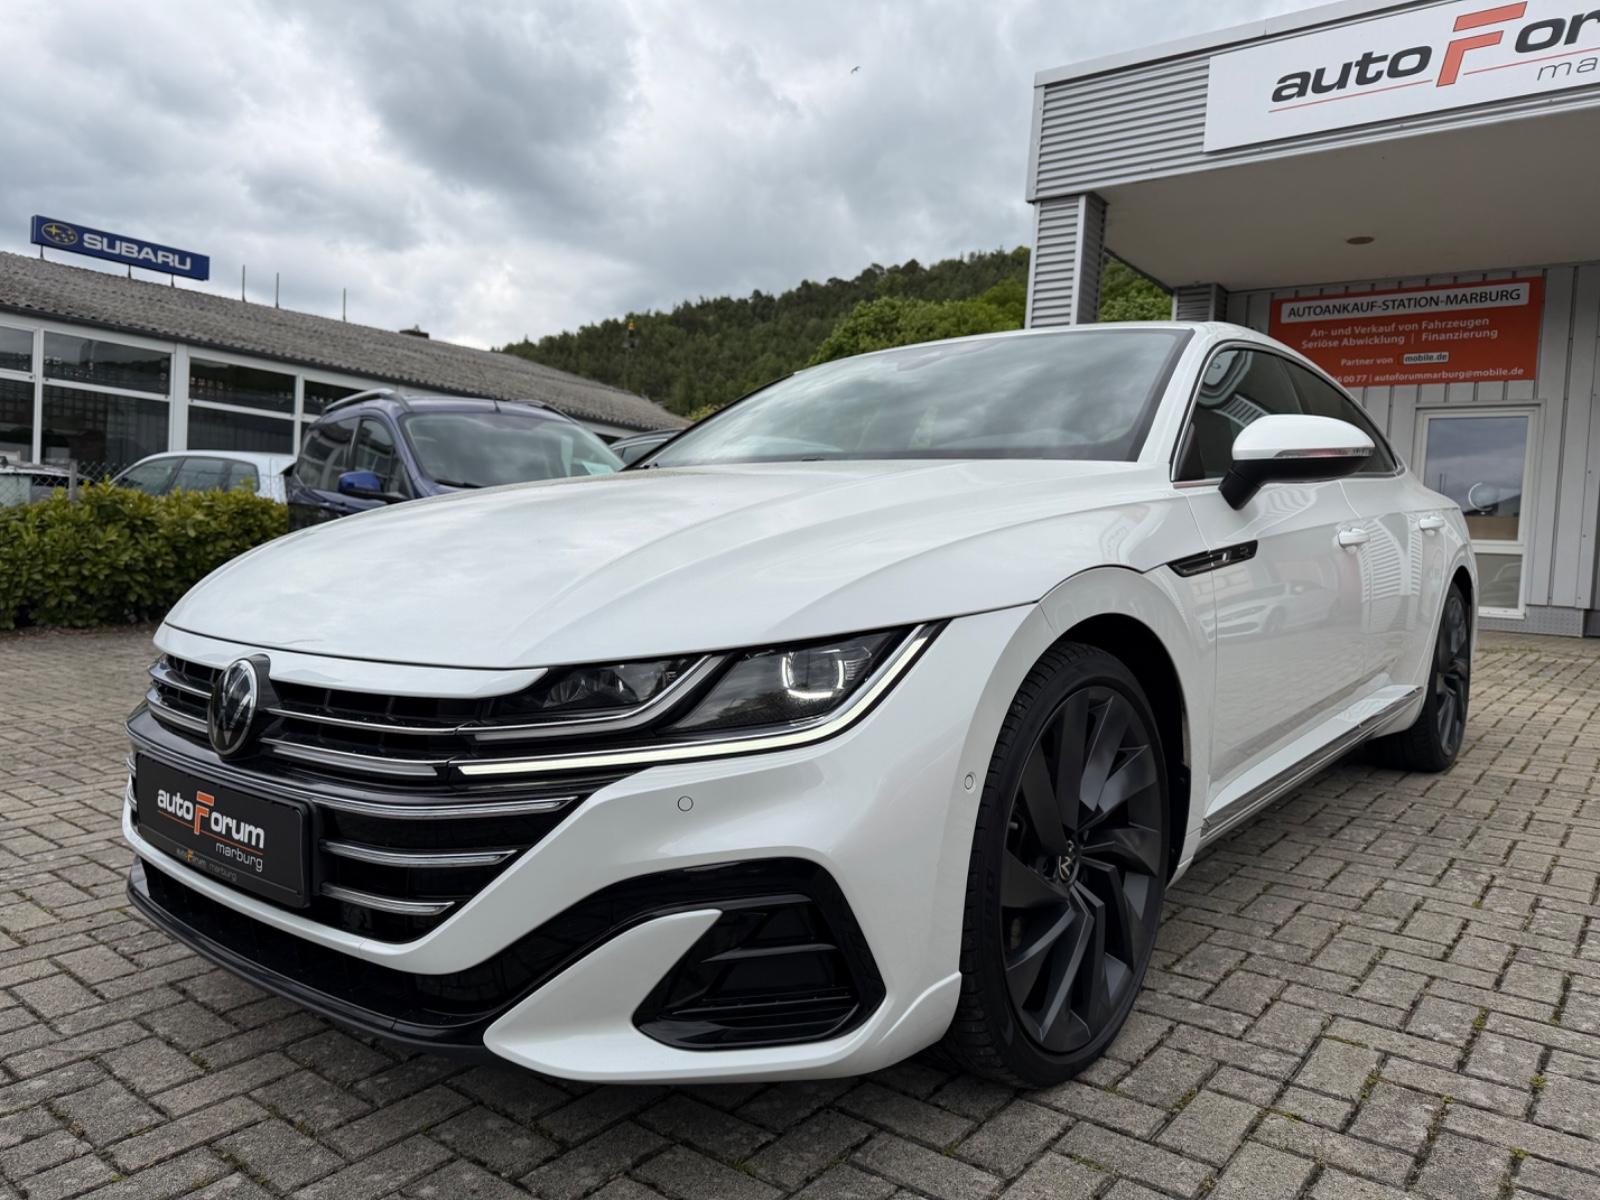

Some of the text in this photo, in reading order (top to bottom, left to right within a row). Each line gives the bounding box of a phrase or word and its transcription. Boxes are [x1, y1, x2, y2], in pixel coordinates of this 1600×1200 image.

[83, 233, 191, 270] SUBARU
[1287, 288, 1521, 318] AUTOANKAUF-STATION-MARBURG
[1302, 340, 1339, 349] Seriöse
[1342, 334, 1405, 347] Abwicklung
[1421, 328, 1499, 342] Finanzierung
[1310, 316, 1490, 337] An- und Verkauf von Fahrzeugen
[1341, 353, 1447, 367] Partner von mobile.de
[1374, 366, 1525, 382] autoforummarburg@mobile.de
[157, 789, 265, 849] autoForum
[215, 842, 263, 872] marburg
